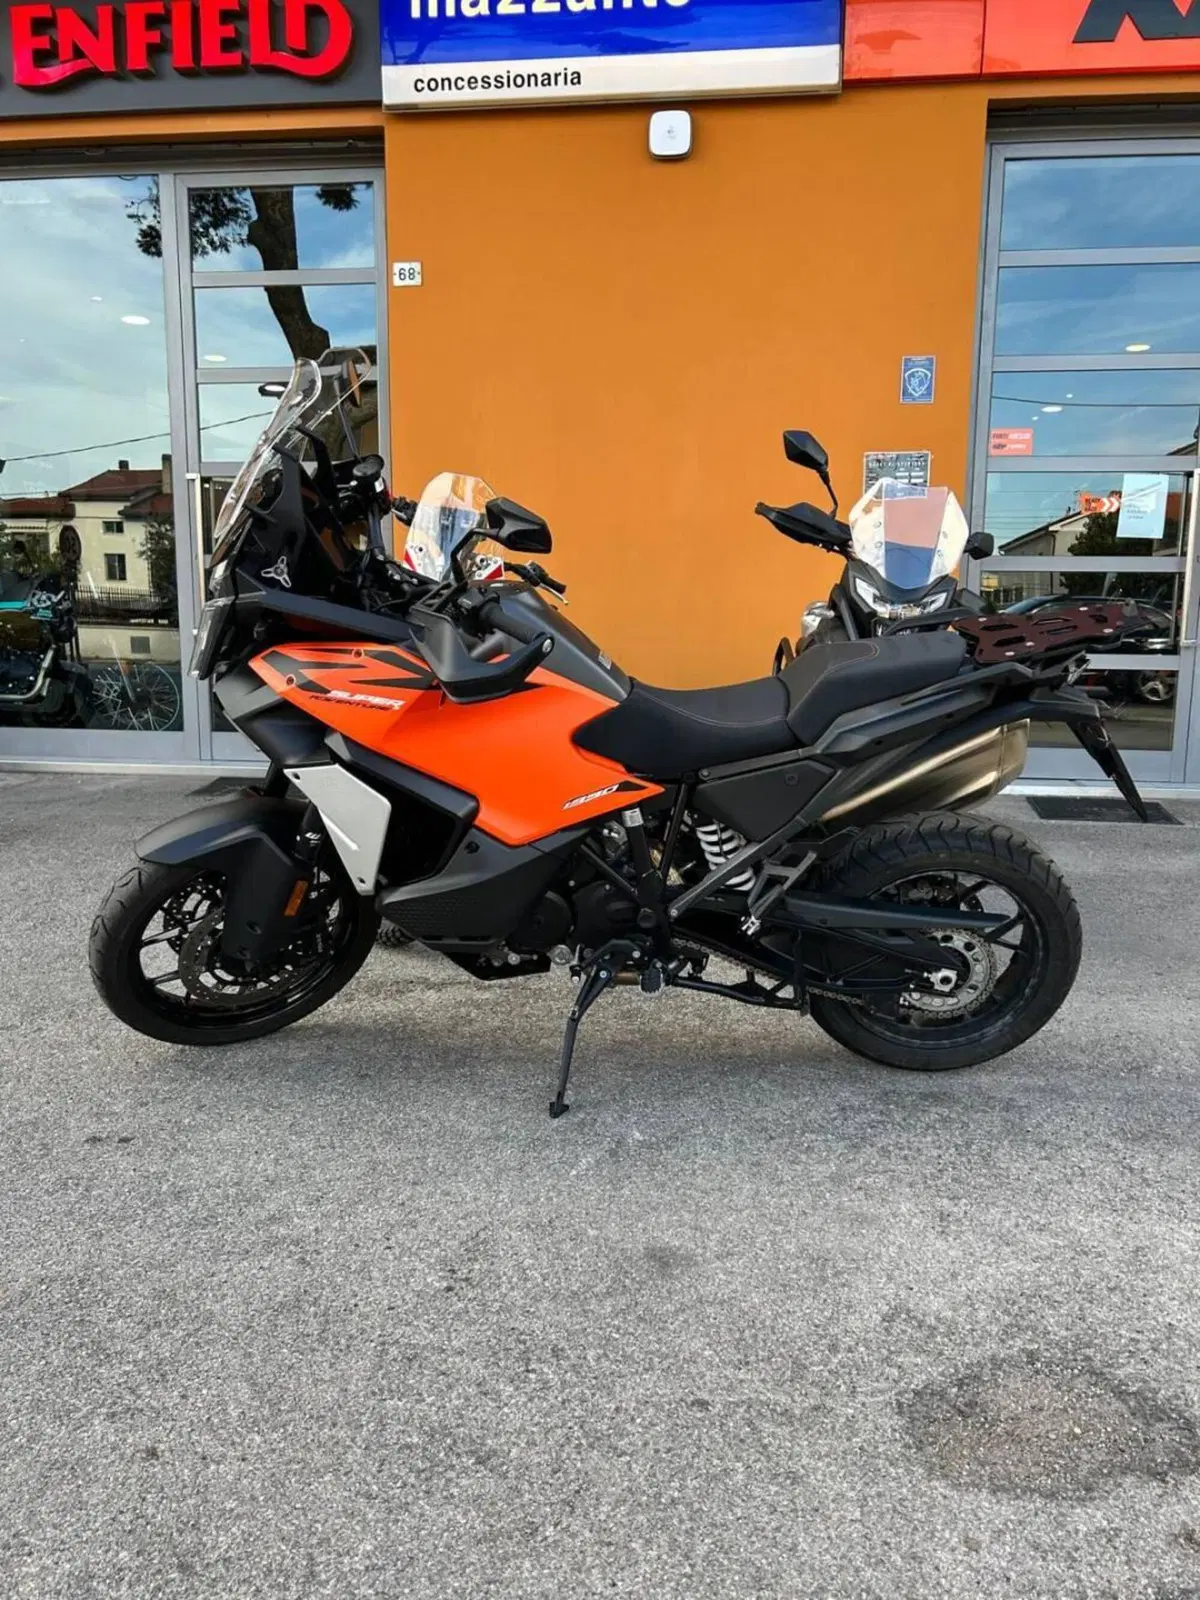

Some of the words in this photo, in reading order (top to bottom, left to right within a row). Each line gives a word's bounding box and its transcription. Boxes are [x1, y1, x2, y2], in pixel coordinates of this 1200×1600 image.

[11, 0, 352, 86] ENFIELD
[413, 67, 582, 93] concessionaria
[398, 267, 415, 281] 68
[326, 690, 406, 706] SUPER
